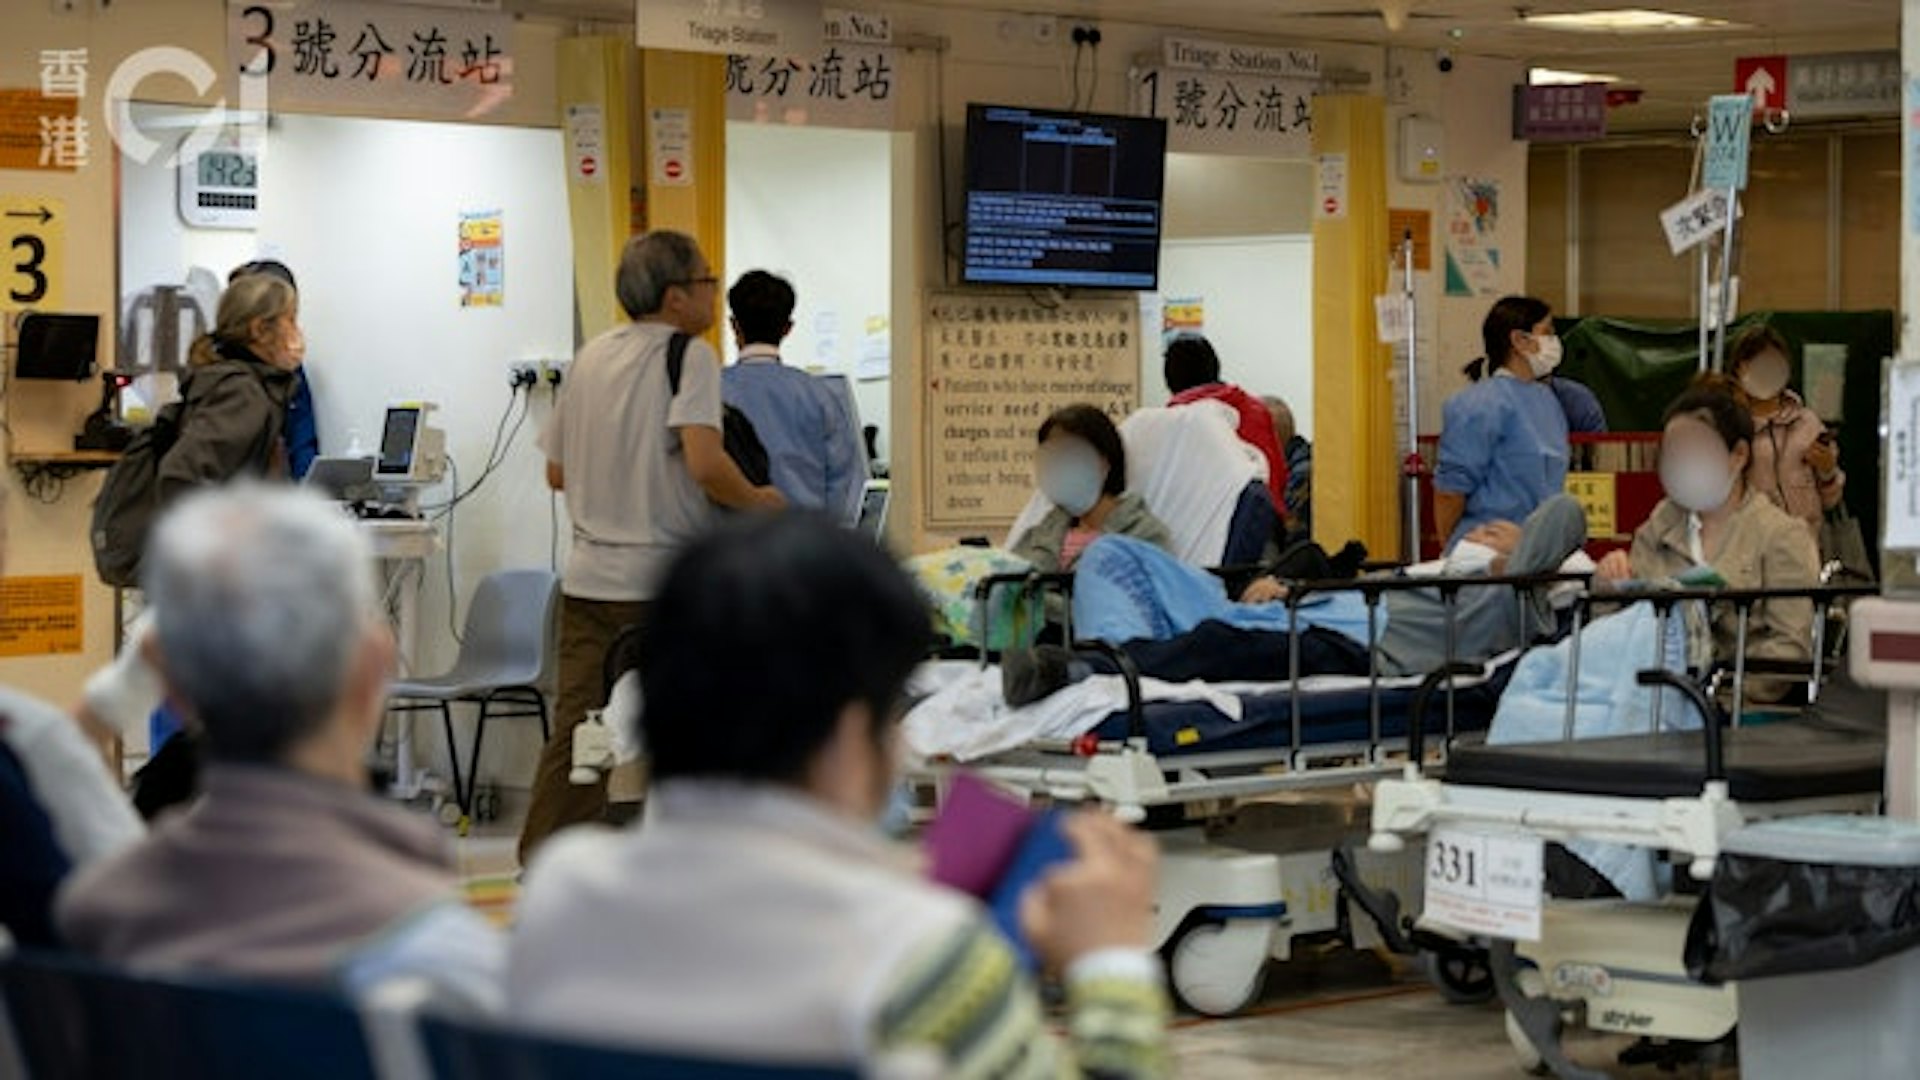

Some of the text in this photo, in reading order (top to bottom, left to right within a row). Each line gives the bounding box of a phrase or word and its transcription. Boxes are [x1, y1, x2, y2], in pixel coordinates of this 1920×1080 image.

[688, 21, 730, 45] Triage
[1172, 42, 1220, 68] Triage
[1229, 49, 1282, 70] Station
[1712, 112, 1744, 143] W
[10, 234, 48, 303] 3
[1430, 840, 1477, 887] 331
